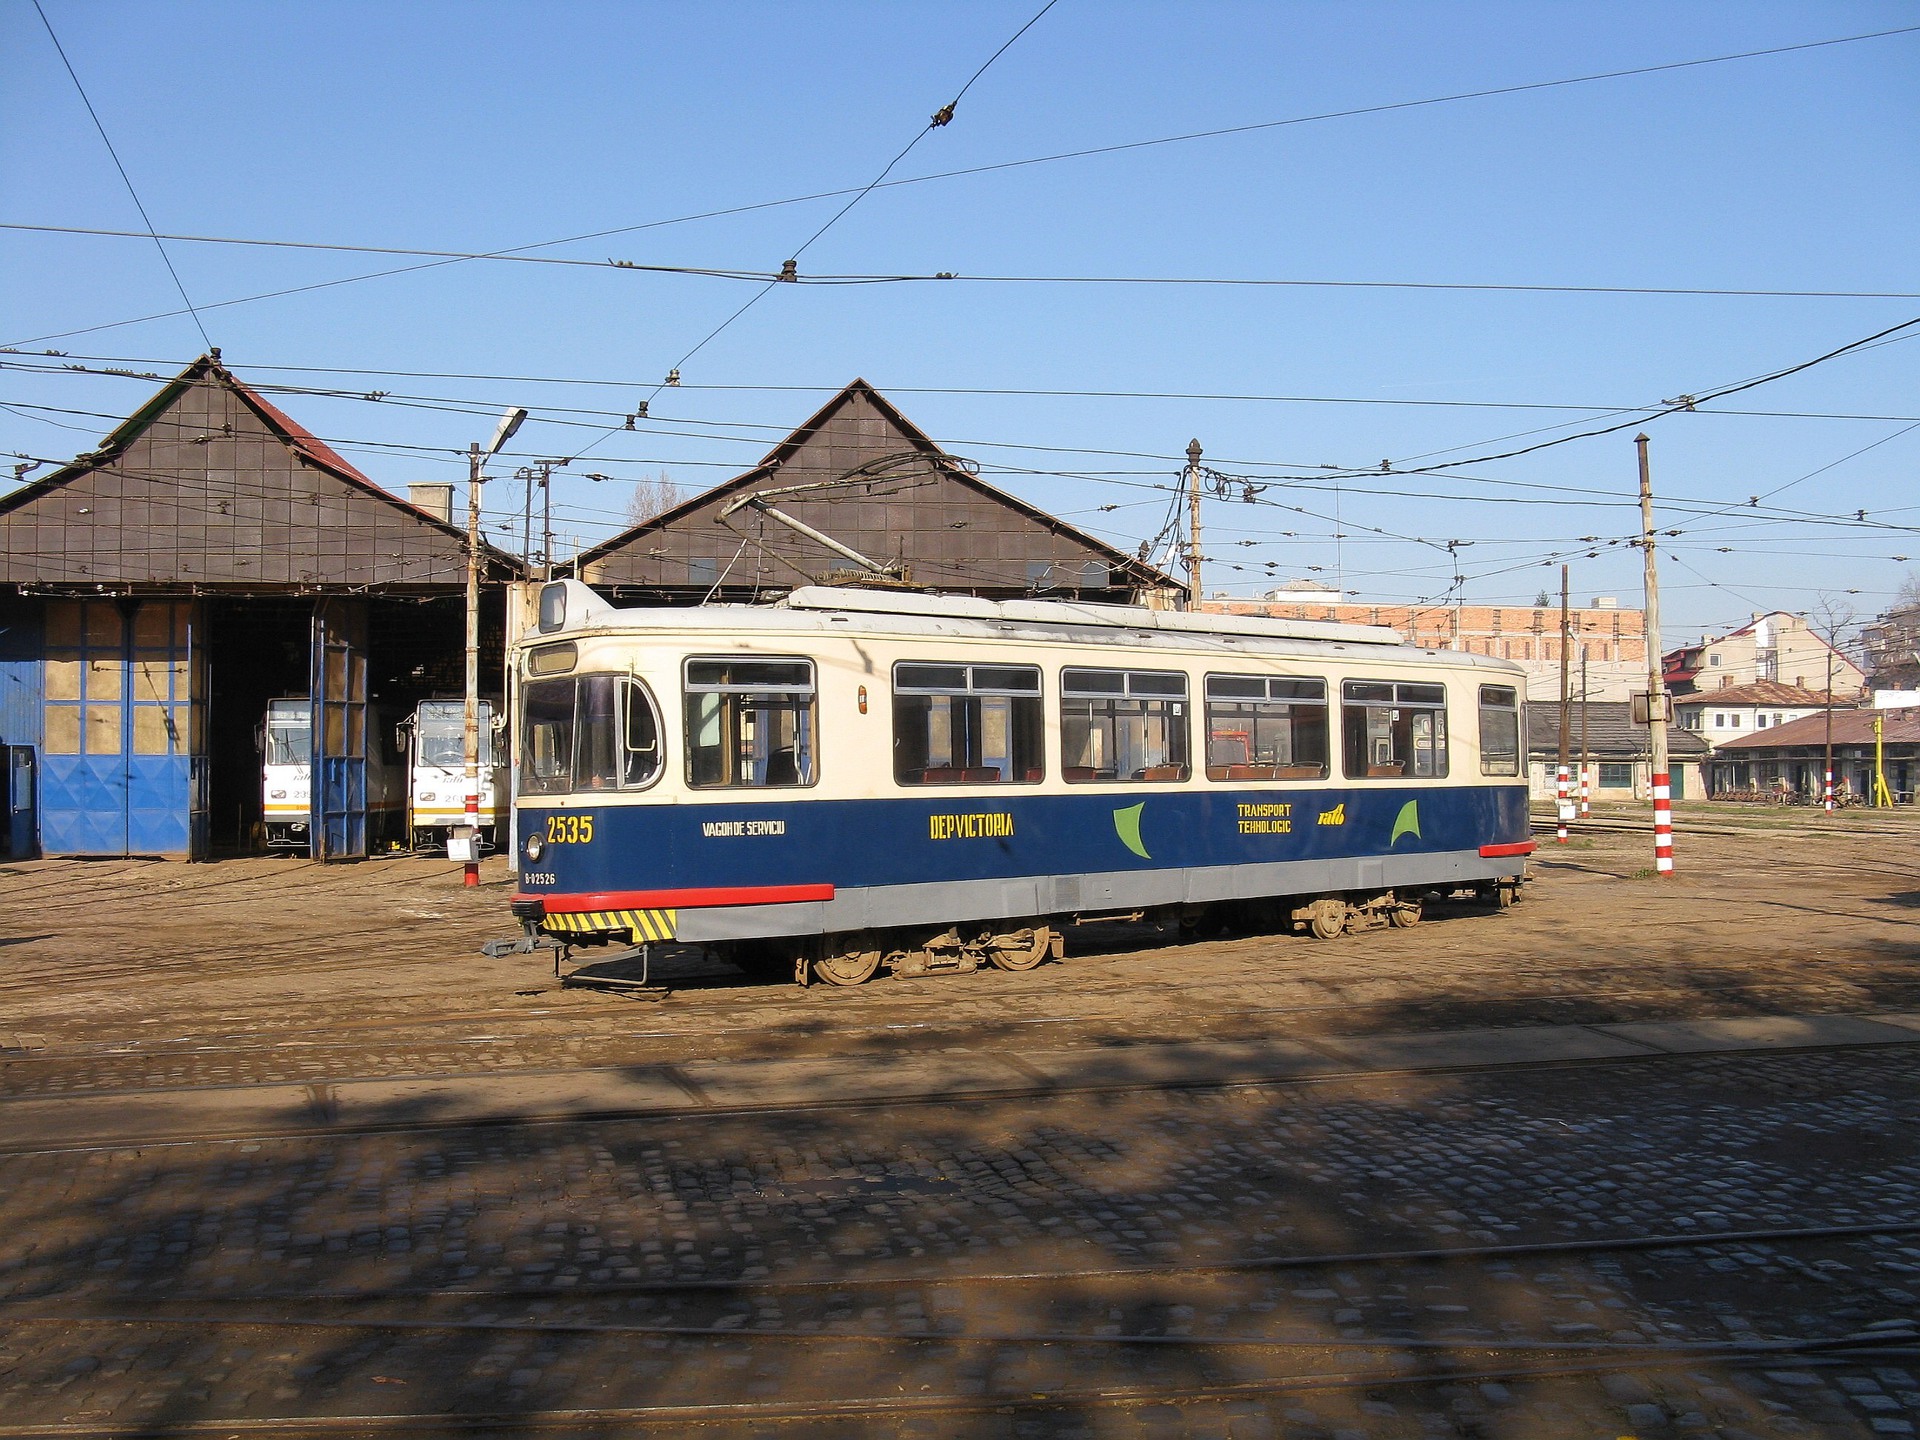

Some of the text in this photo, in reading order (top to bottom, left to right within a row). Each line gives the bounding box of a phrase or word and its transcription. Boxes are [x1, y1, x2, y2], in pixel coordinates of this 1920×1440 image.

[1237, 804, 1291, 817] TRANSPORT
[1317, 803, 1345, 825] ratb
[547, 815, 593, 844] 2535
[746, 820, 785, 836] SERVICIU
